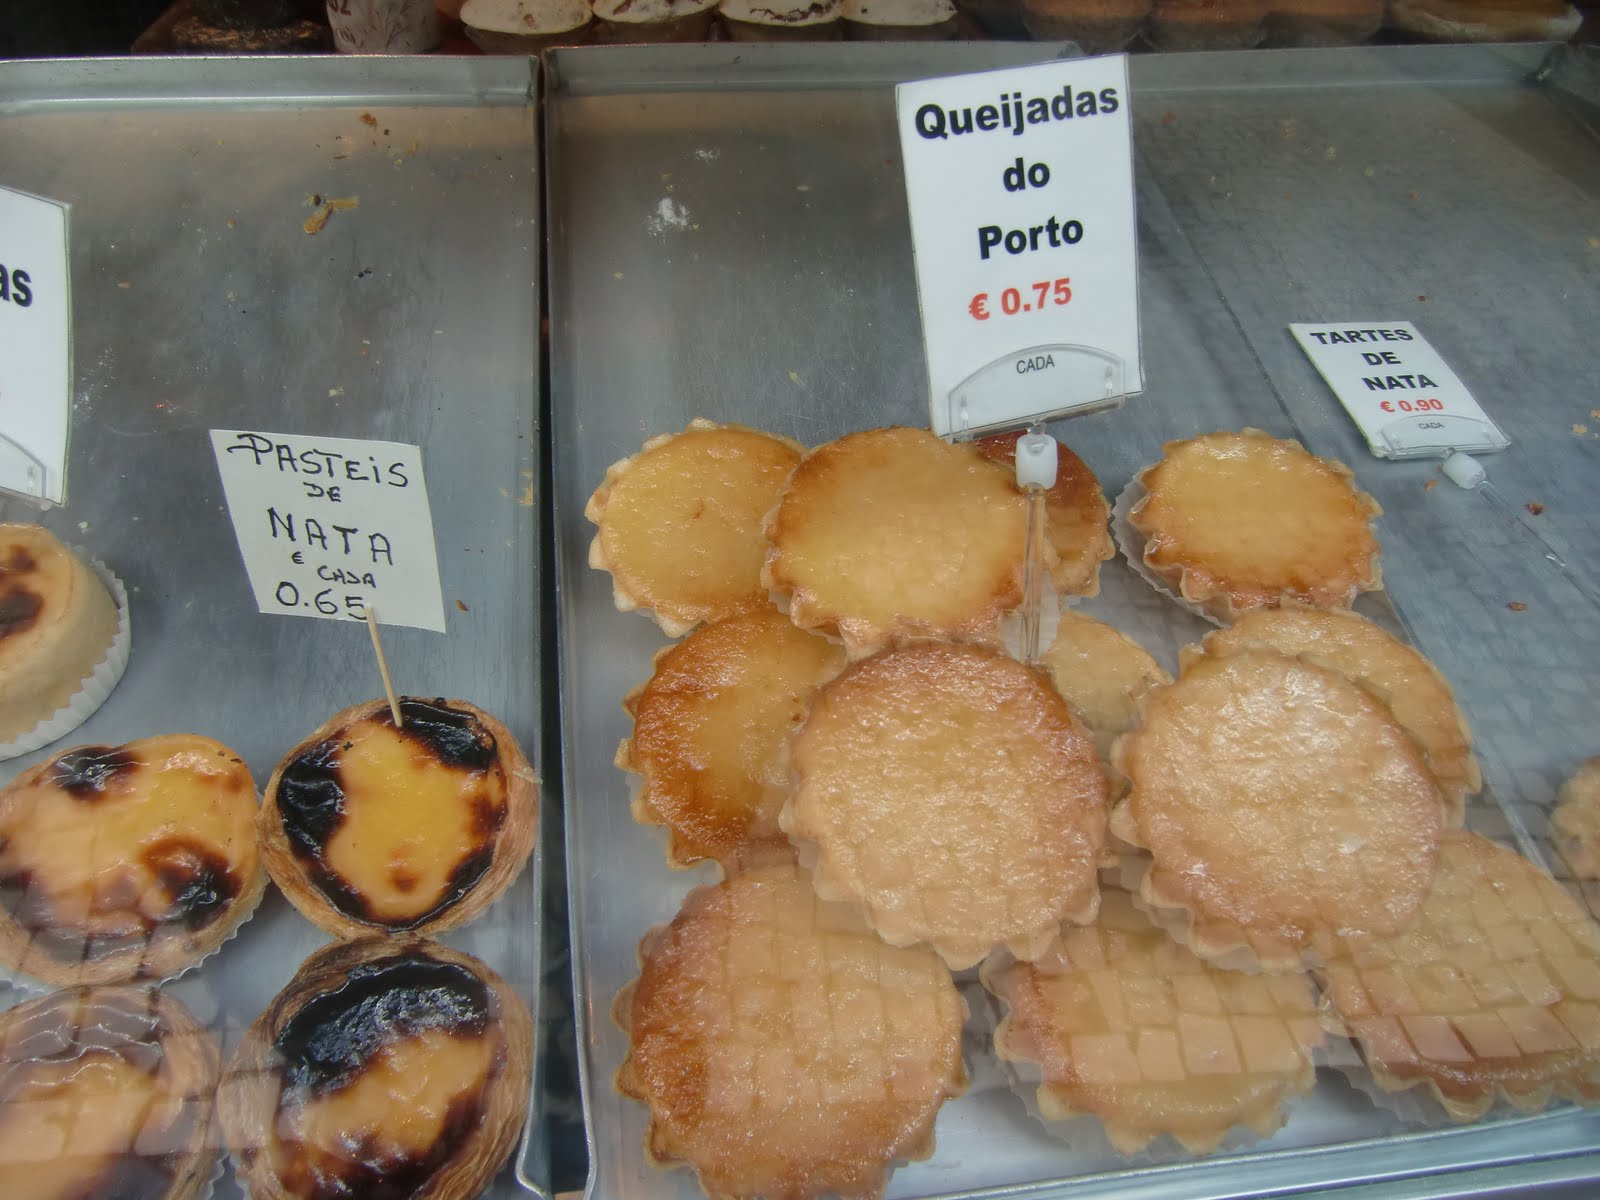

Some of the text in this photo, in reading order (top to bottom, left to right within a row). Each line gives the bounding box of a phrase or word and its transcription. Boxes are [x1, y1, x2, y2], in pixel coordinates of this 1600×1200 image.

[915, 85, 1119, 140] Queijadas
[1003, 157, 1050, 192] do
[978, 216, 1083, 260] Porto
[968, 277, 1072, 320] € 0.75
[1309, 329, 1414, 345] TARTES
[1016, 354, 1055, 374] CADA
[1361, 351, 1401, 366] DE
[1361, 374, 1439, 391] NATA
[1379, 398, 1444, 413] € 0.90
[1418, 421, 1446, 430] CADA
[303, 482, 342, 502] DE
[267, 506, 394, 566] NATA
[317, 565, 377, 588] CADA
[275, 581, 369, 621] 0.65
